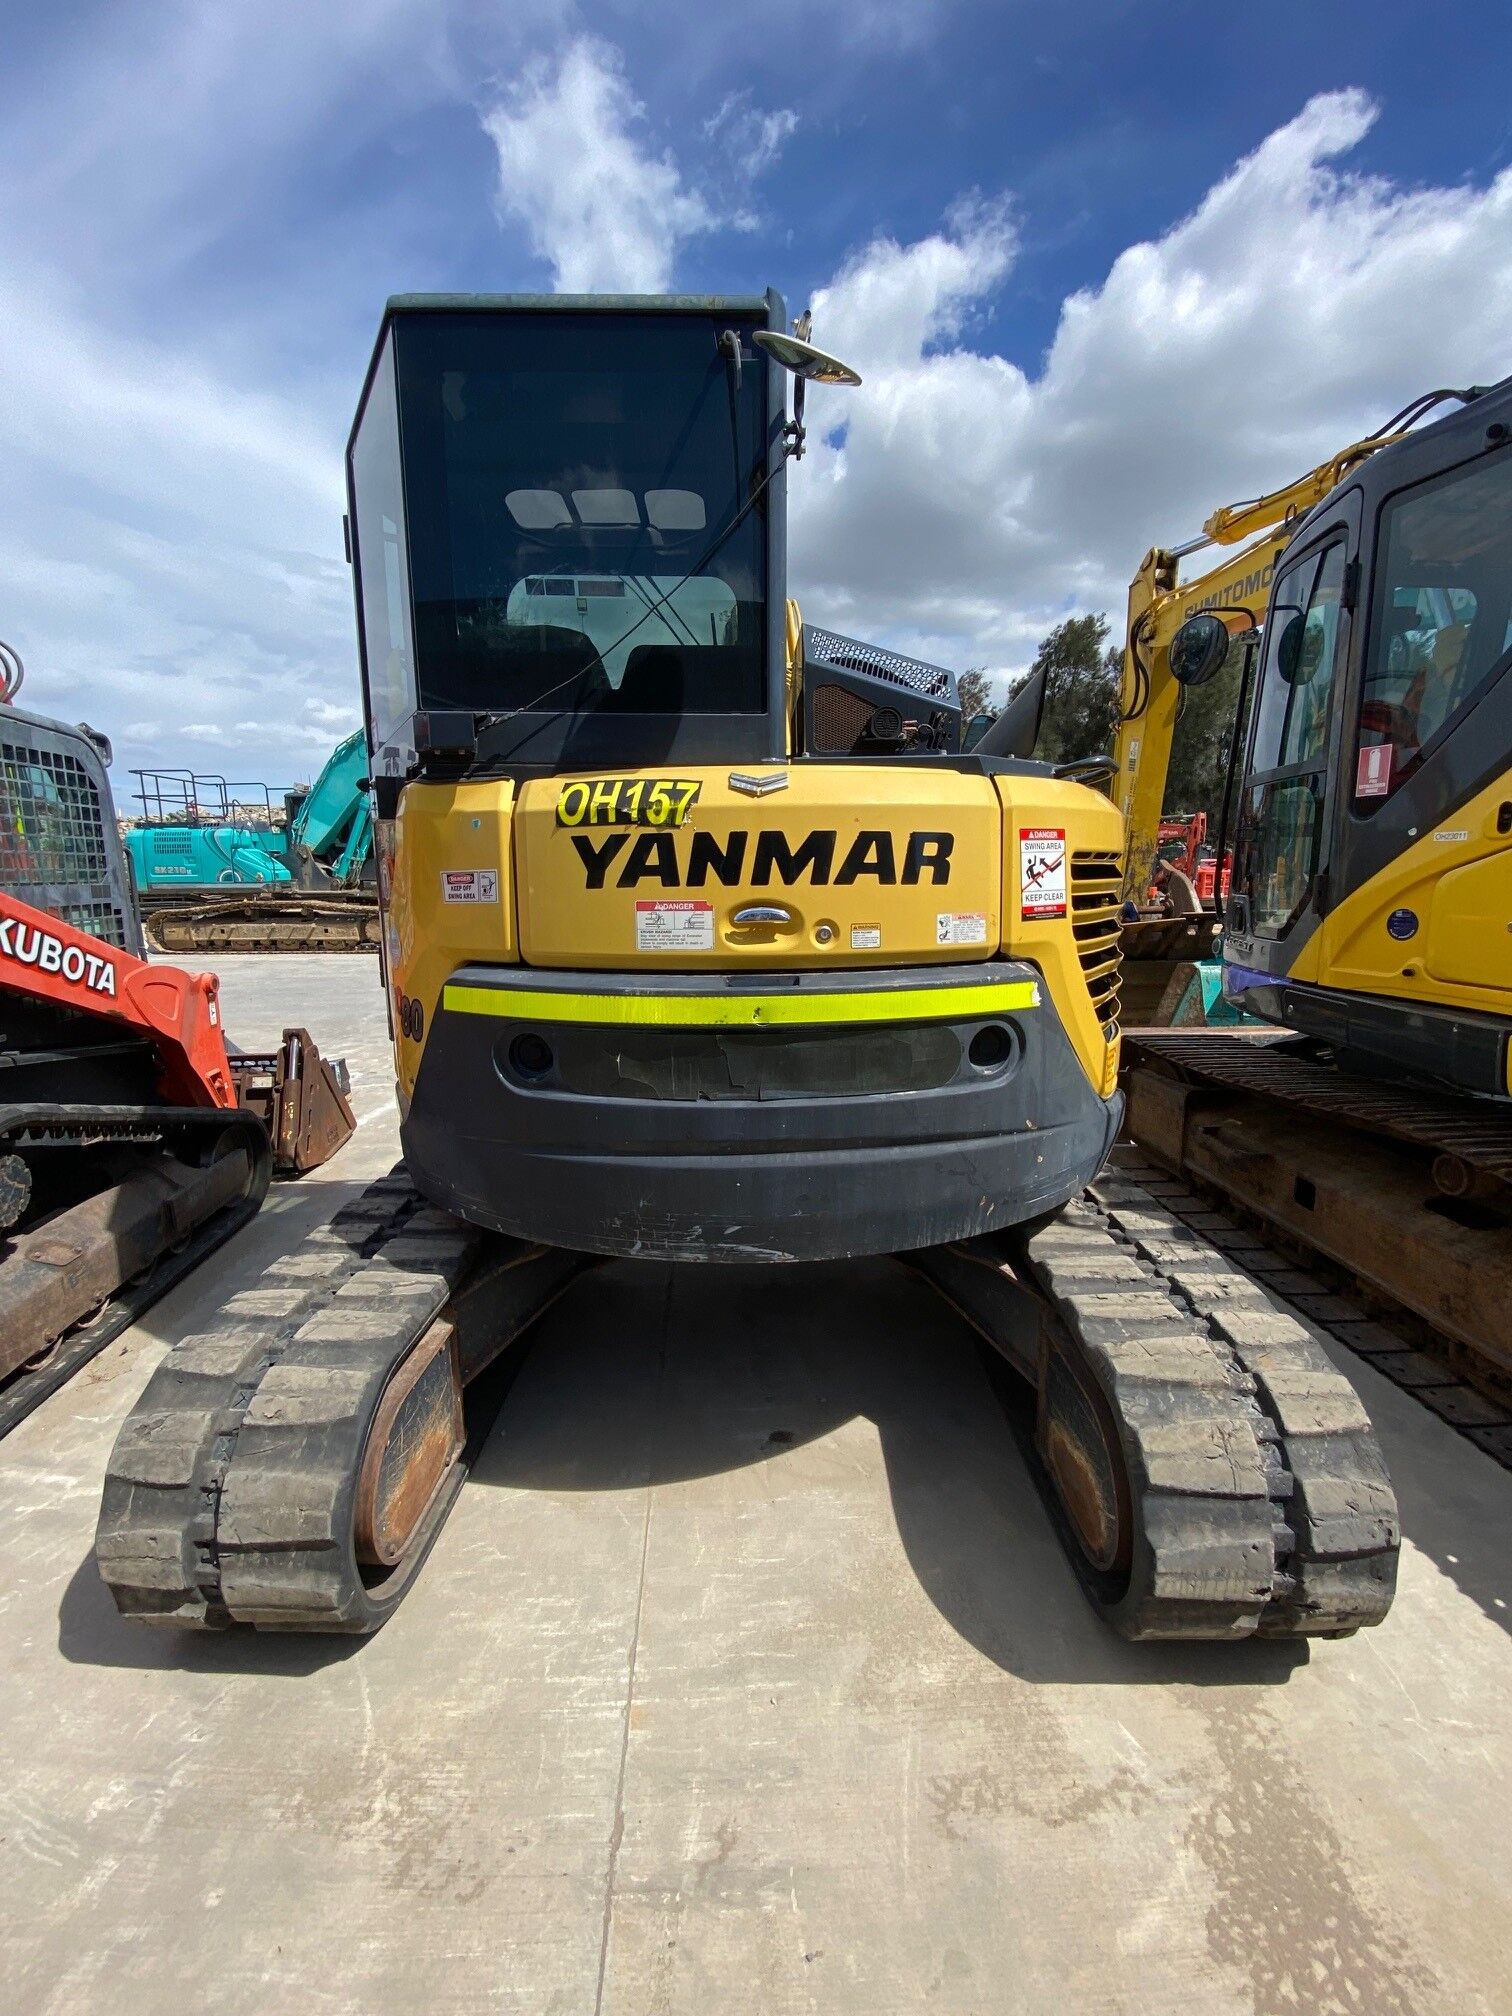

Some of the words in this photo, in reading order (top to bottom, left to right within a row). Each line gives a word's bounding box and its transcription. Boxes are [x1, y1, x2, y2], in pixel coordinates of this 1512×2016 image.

[558, 781, 700, 826] OH157
[570, 832, 955, 889] YANMAR
[1046, 842, 1062, 850] AREA
[1025, 894, 1042, 902] KEEP
[1043, 892, 1064, 901] CLEAR
[0, 917, 116, 996] KUBOTA
